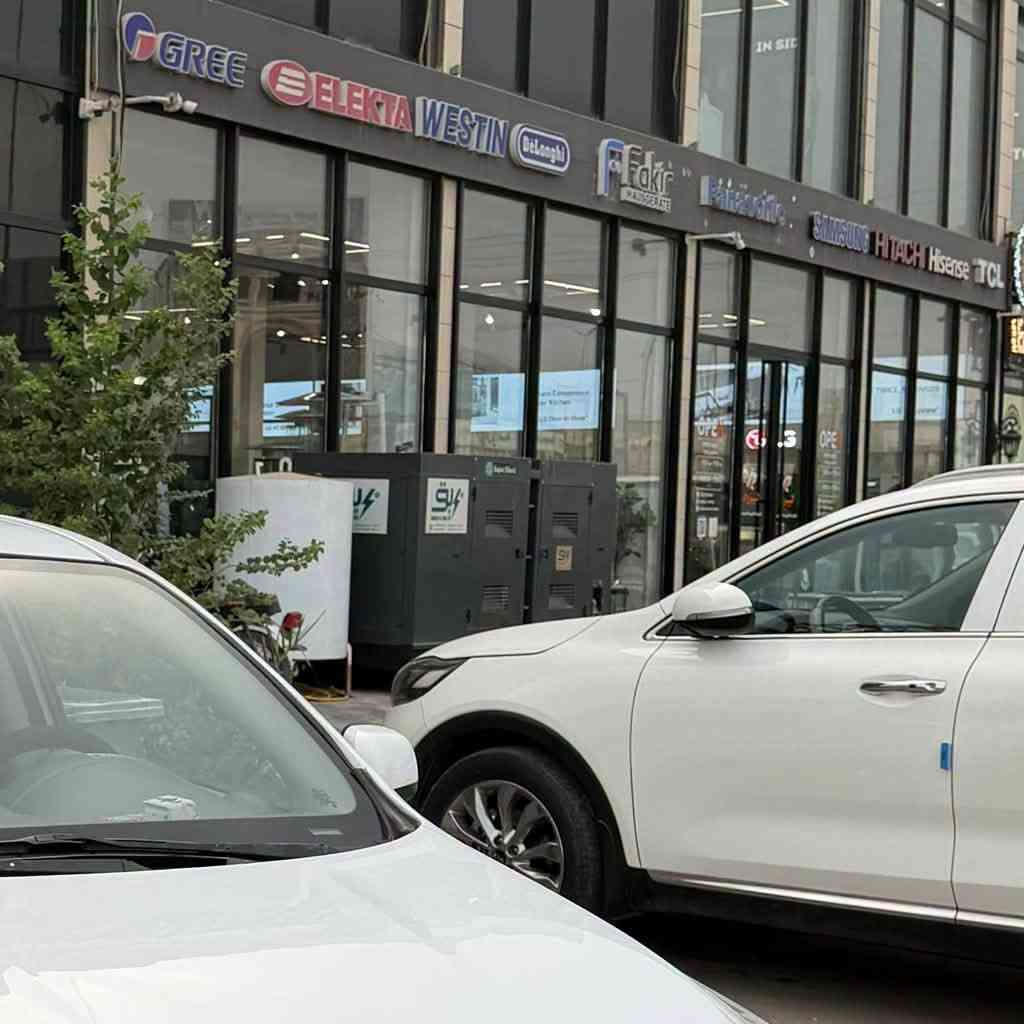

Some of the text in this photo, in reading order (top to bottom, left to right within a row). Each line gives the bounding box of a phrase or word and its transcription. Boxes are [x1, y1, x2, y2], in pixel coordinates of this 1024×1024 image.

[159, 32, 247, 88] GREE
[312, 72, 413, 133] ELEKTA
[418, 96, 510, 158] WESTIN
[621, 143, 674, 196] Fakir
[812, 212, 870, 254] SAMSUNG
[874, 229, 925, 270] HITACHI
[928, 245, 970, 281] Hisense
[974, 258, 1005, 289] TCL
